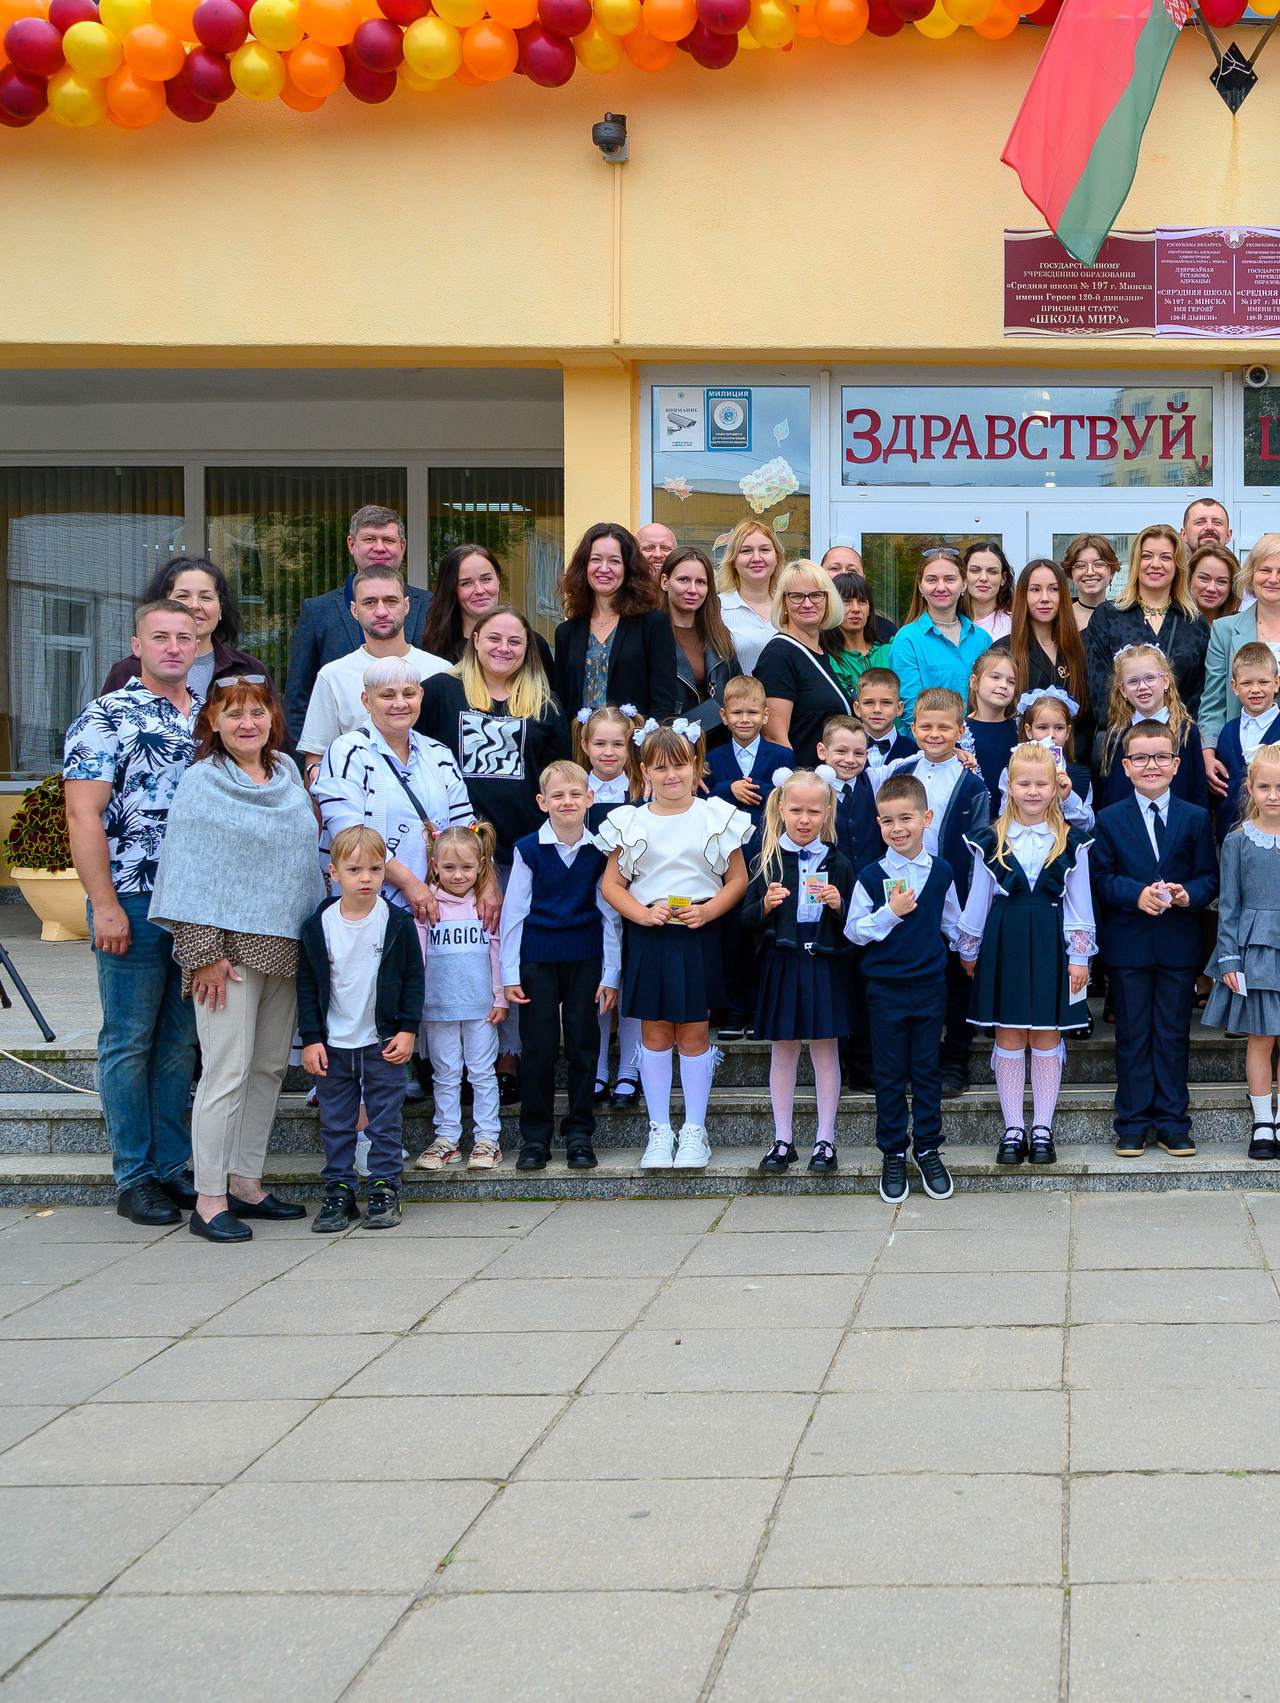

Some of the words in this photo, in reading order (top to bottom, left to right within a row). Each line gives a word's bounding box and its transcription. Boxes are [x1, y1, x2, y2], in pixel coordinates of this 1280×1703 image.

[1040, 262, 1120, 270] ГОСУДАРСТННОМУ
[1006, 282, 1048, 290] «Средняя
[1080, 282, 1089, 290] №
[1092, 282, 1108, 290] 197
[1119, 282, 1153, 290] Минска
[1236, 289, 1279, 297] «СРЕДНЯЯ
[1046, 293, 1077, 302] Героев
[1079, 293, 1100, 301] 120-й
[1030, 315, 1084, 324] «ШКОЛА
[1088, 315, 1130, 325] МИРА»
[708, 390, 749, 398] МИЛИЦИЯ
